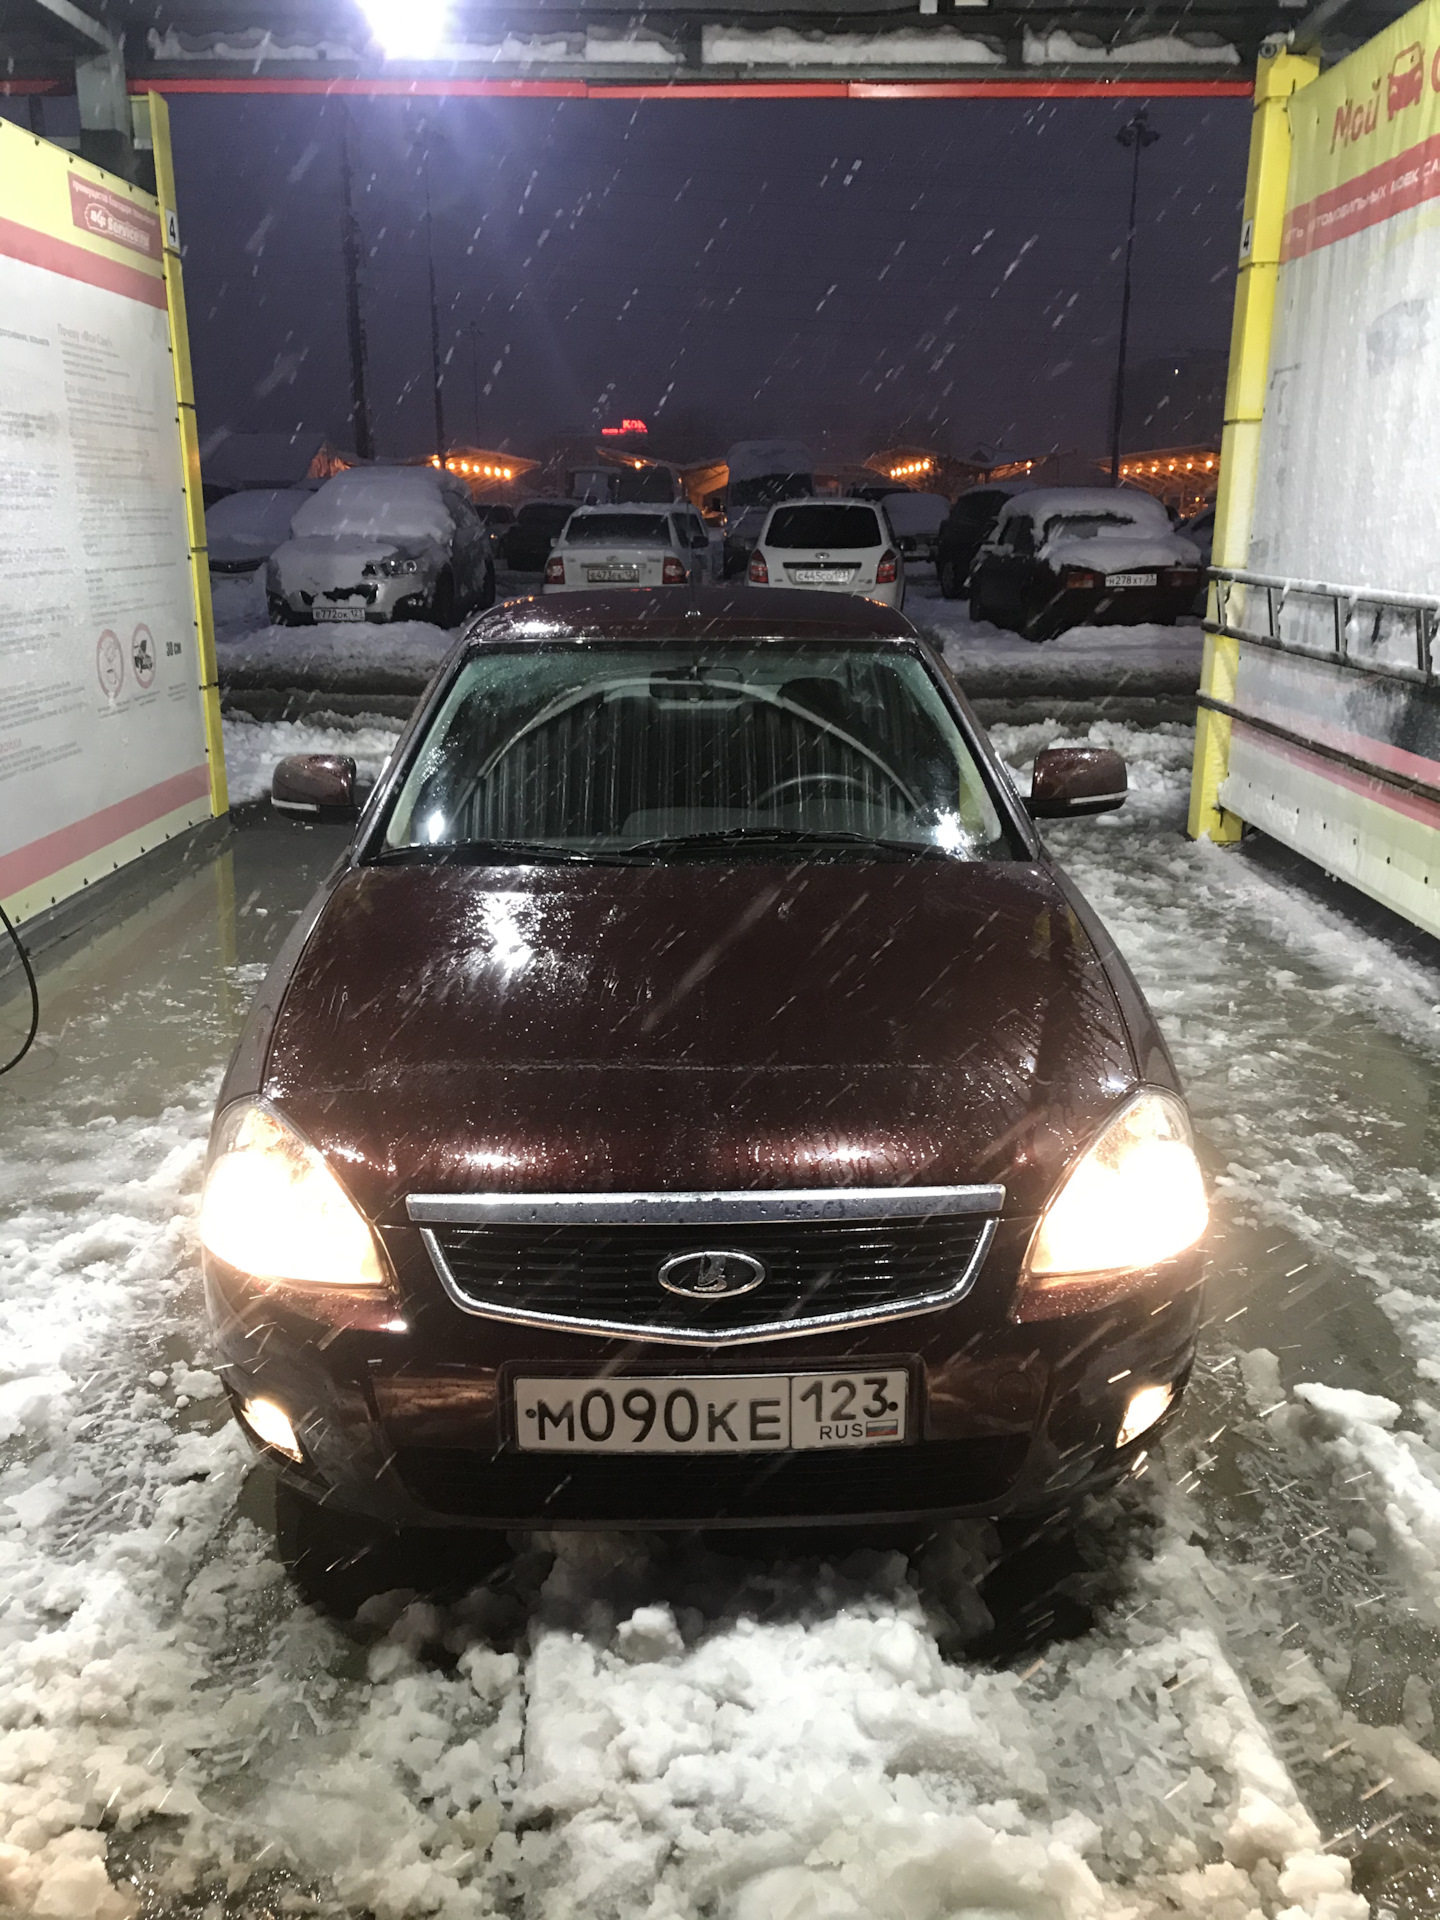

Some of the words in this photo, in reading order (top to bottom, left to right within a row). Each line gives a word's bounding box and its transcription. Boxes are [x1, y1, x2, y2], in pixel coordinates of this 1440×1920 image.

[1330, 76, 1381, 156] Мой
[169, 215, 177, 243] 4
[1243, 225, 1251, 251] 4
[1109, 575, 1142, 585] Н278ХТ
[315, 610, 348, 619] Е772ОК
[537, 1387, 782, 1443] М090КЕ
[800, 1376, 889, 1423] 123
[820, 1421, 863, 1440] RUS
